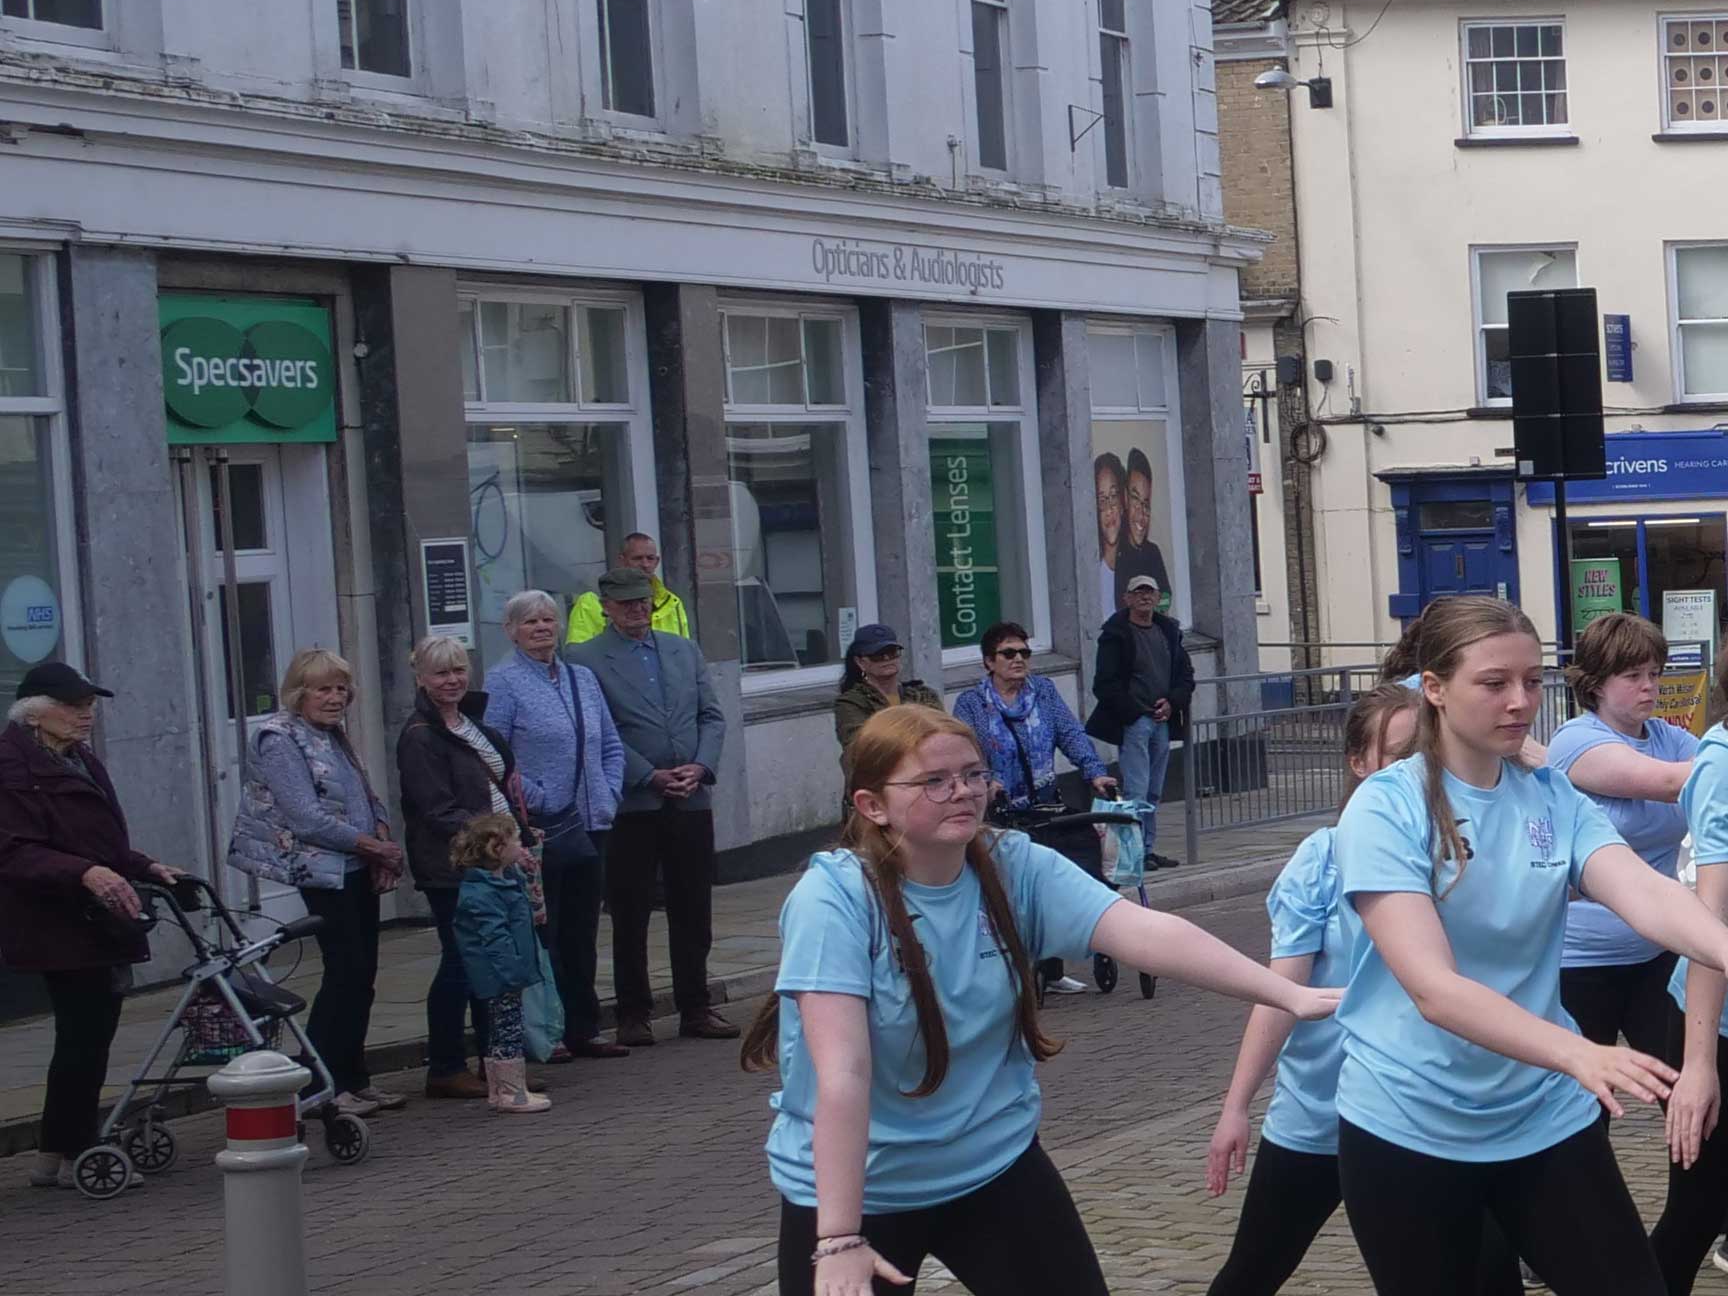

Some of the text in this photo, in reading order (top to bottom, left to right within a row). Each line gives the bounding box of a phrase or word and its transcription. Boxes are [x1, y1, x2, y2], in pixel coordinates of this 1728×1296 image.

[812, 238, 1004, 295] Opticians & Audiologists
[175, 347, 318, 395] Specsavers
[1674, 460, 1710, 469] HEARING
[947, 456, 977, 637] Contact Lenses
[1584, 569, 1608, 584] NEW
[1578, 583, 1616, 598] STYLES
[1666, 595, 1711, 604] SIGHT TESTS
[27, 607, 53, 622] NHS
